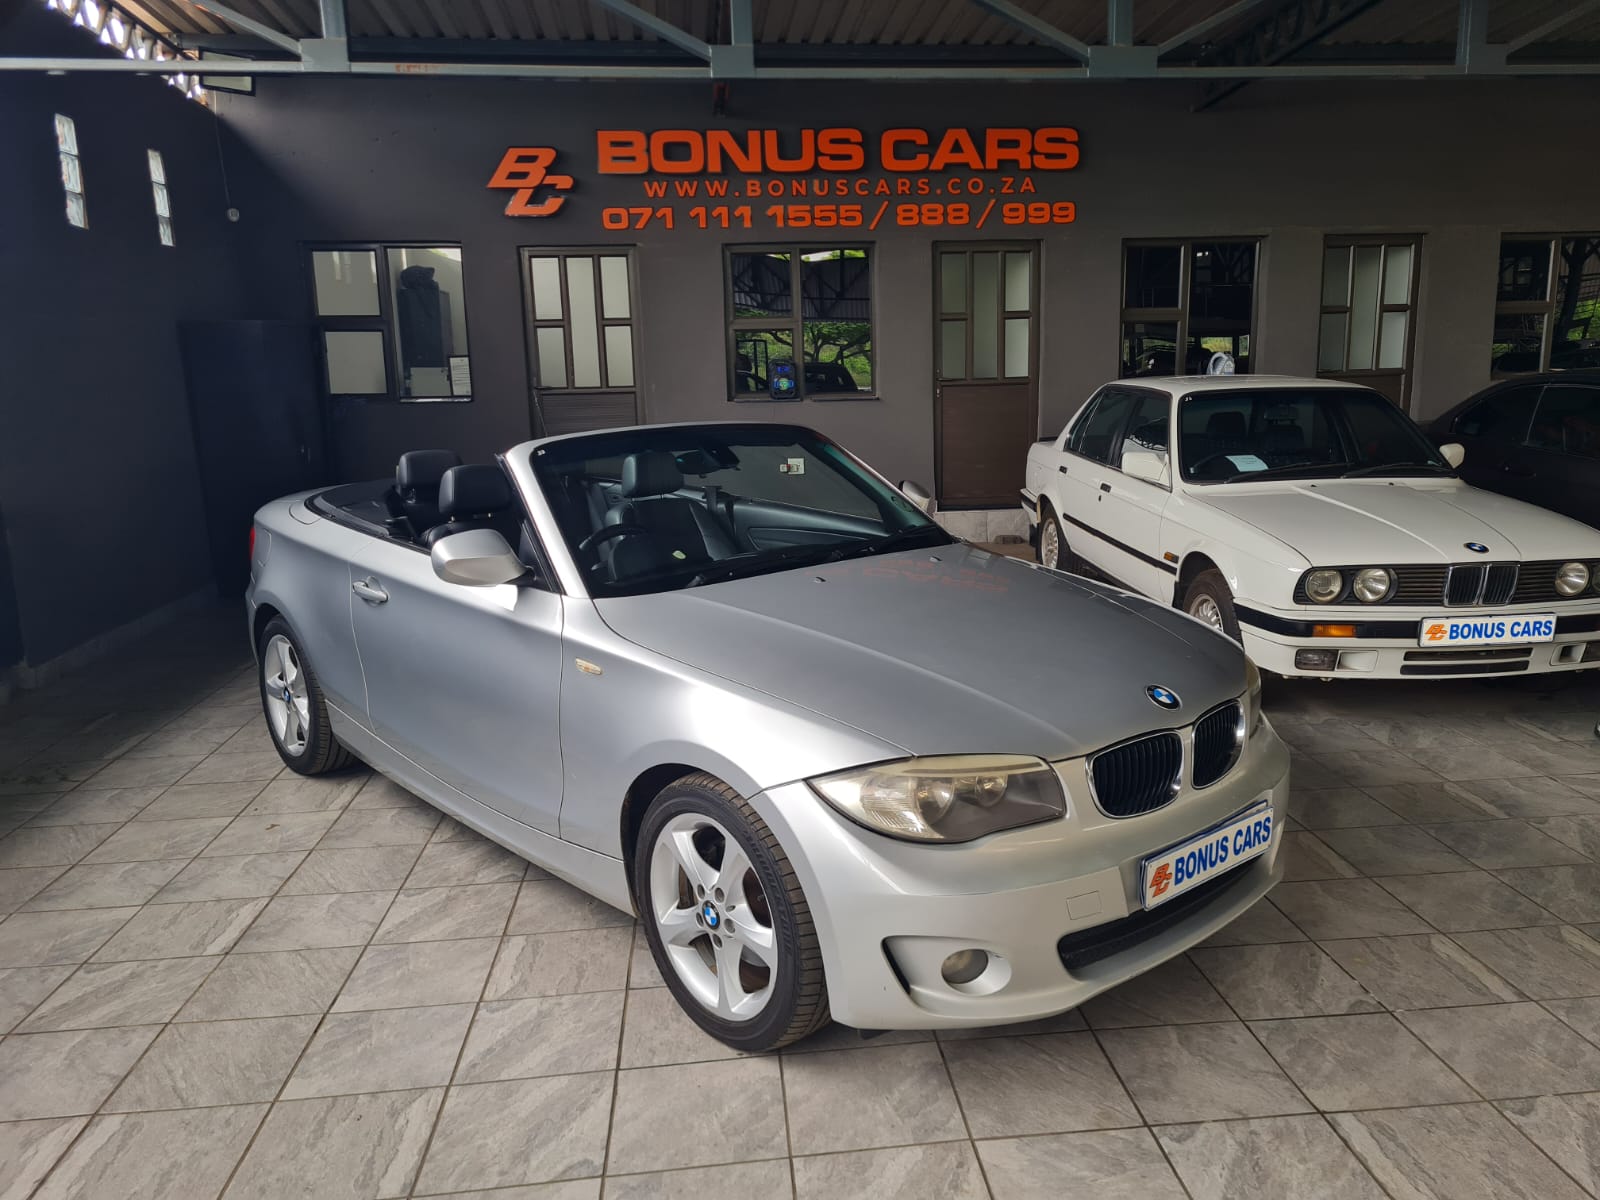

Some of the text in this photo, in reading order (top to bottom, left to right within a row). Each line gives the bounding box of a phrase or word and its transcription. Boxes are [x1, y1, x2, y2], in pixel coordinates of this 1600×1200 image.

[597, 128, 1079, 174] BONUS CARS
[486, 147, 574, 216] BC
[643, 177, 1035, 198] WWW.BONUSCARS.CO.ZA
[602, 207, 674, 230] 071
[689, 205, 752, 229] 111
[1449, 622, 1505, 640] BONUS
[1510, 620, 1553, 637] CARS
[1174, 836, 1229, 886] BONUS
[1233, 816, 1271, 856] CARS
